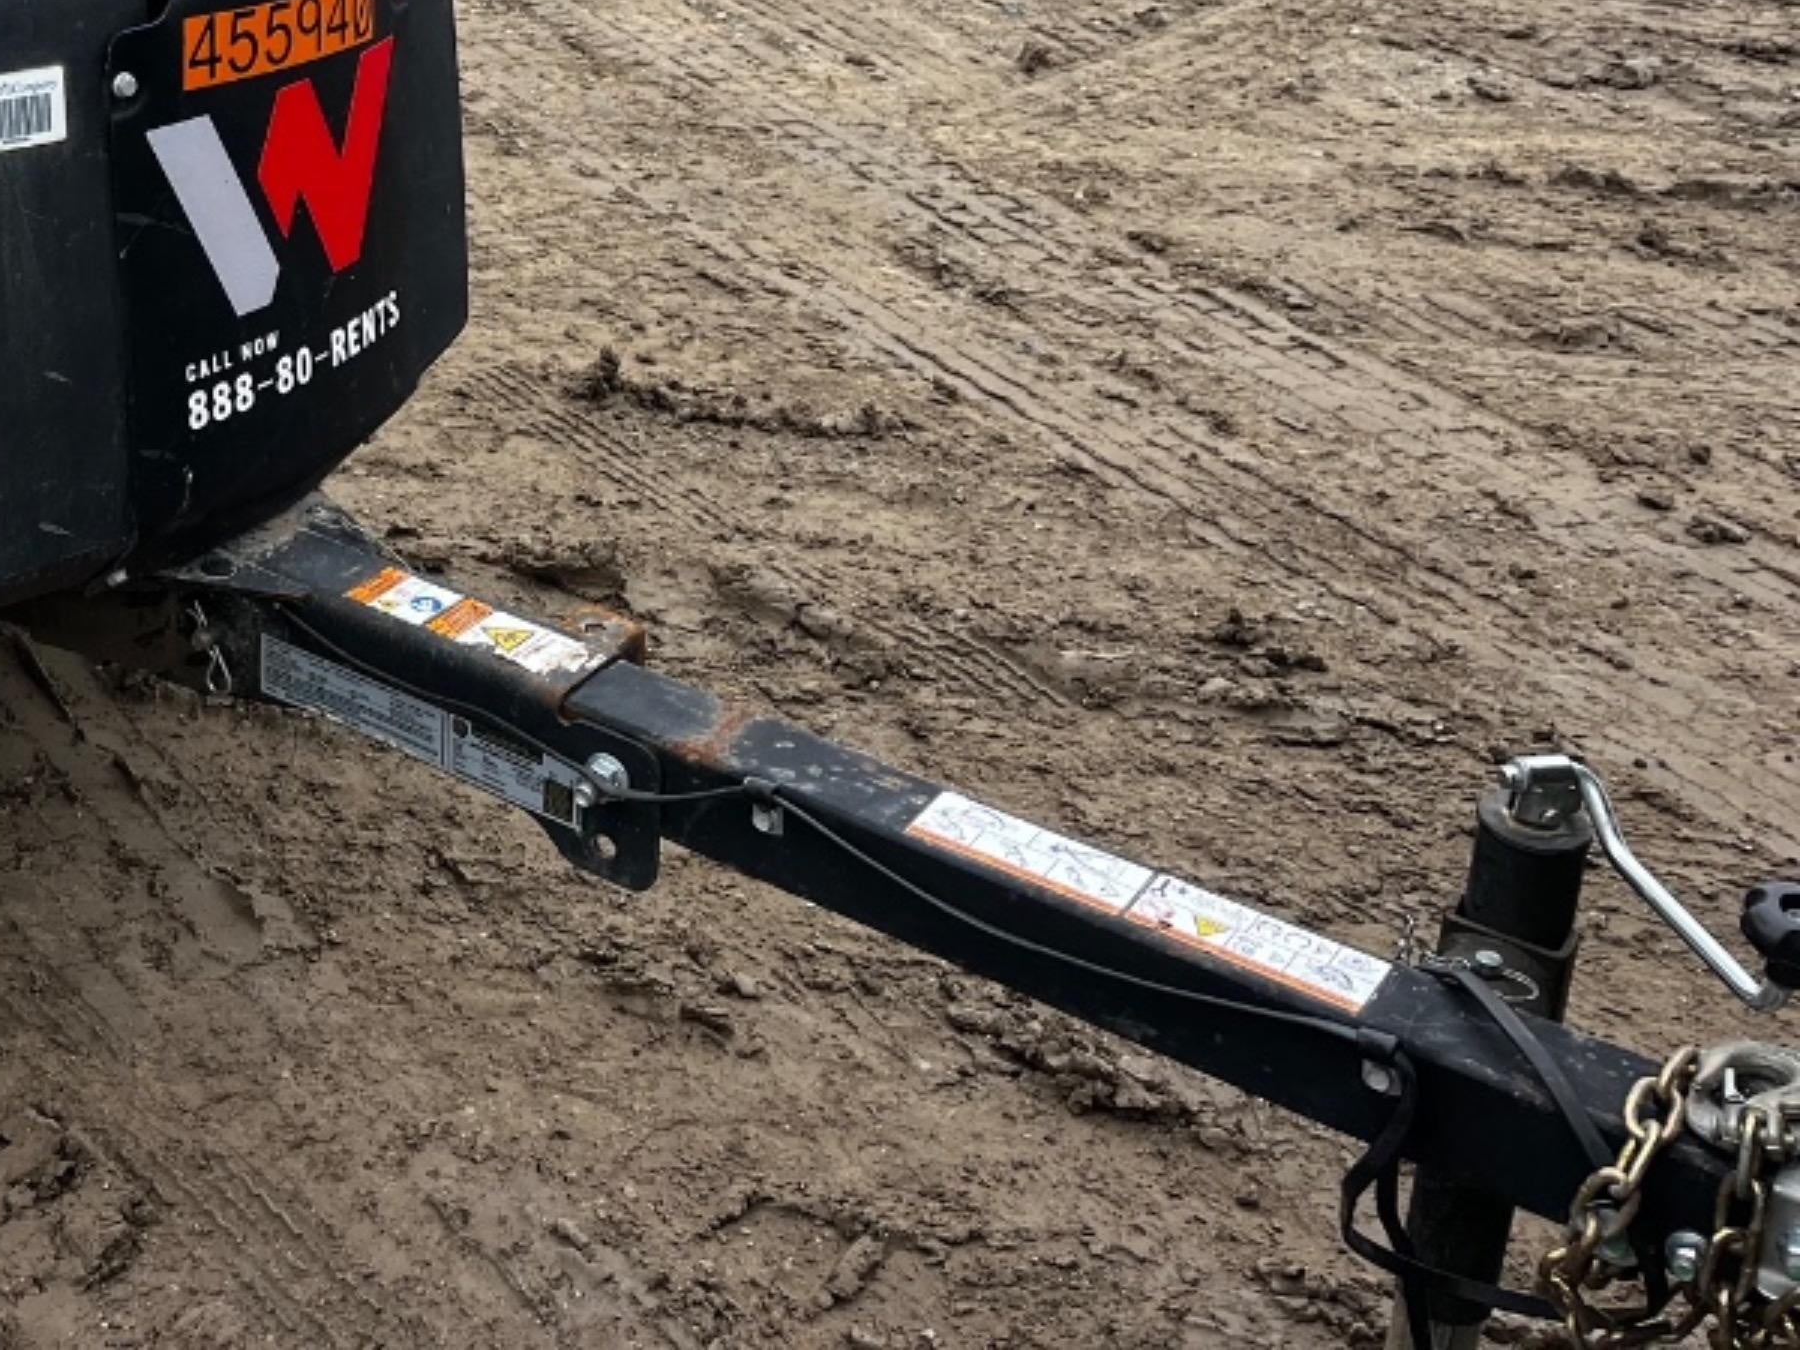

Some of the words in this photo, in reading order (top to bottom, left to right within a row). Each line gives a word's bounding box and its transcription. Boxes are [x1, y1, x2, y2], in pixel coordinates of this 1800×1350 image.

[185, 350, 234, 382] CALL
[240, 329, 280, 361] NOW
[187, 291, 401, 430] 888-80-RENTS
